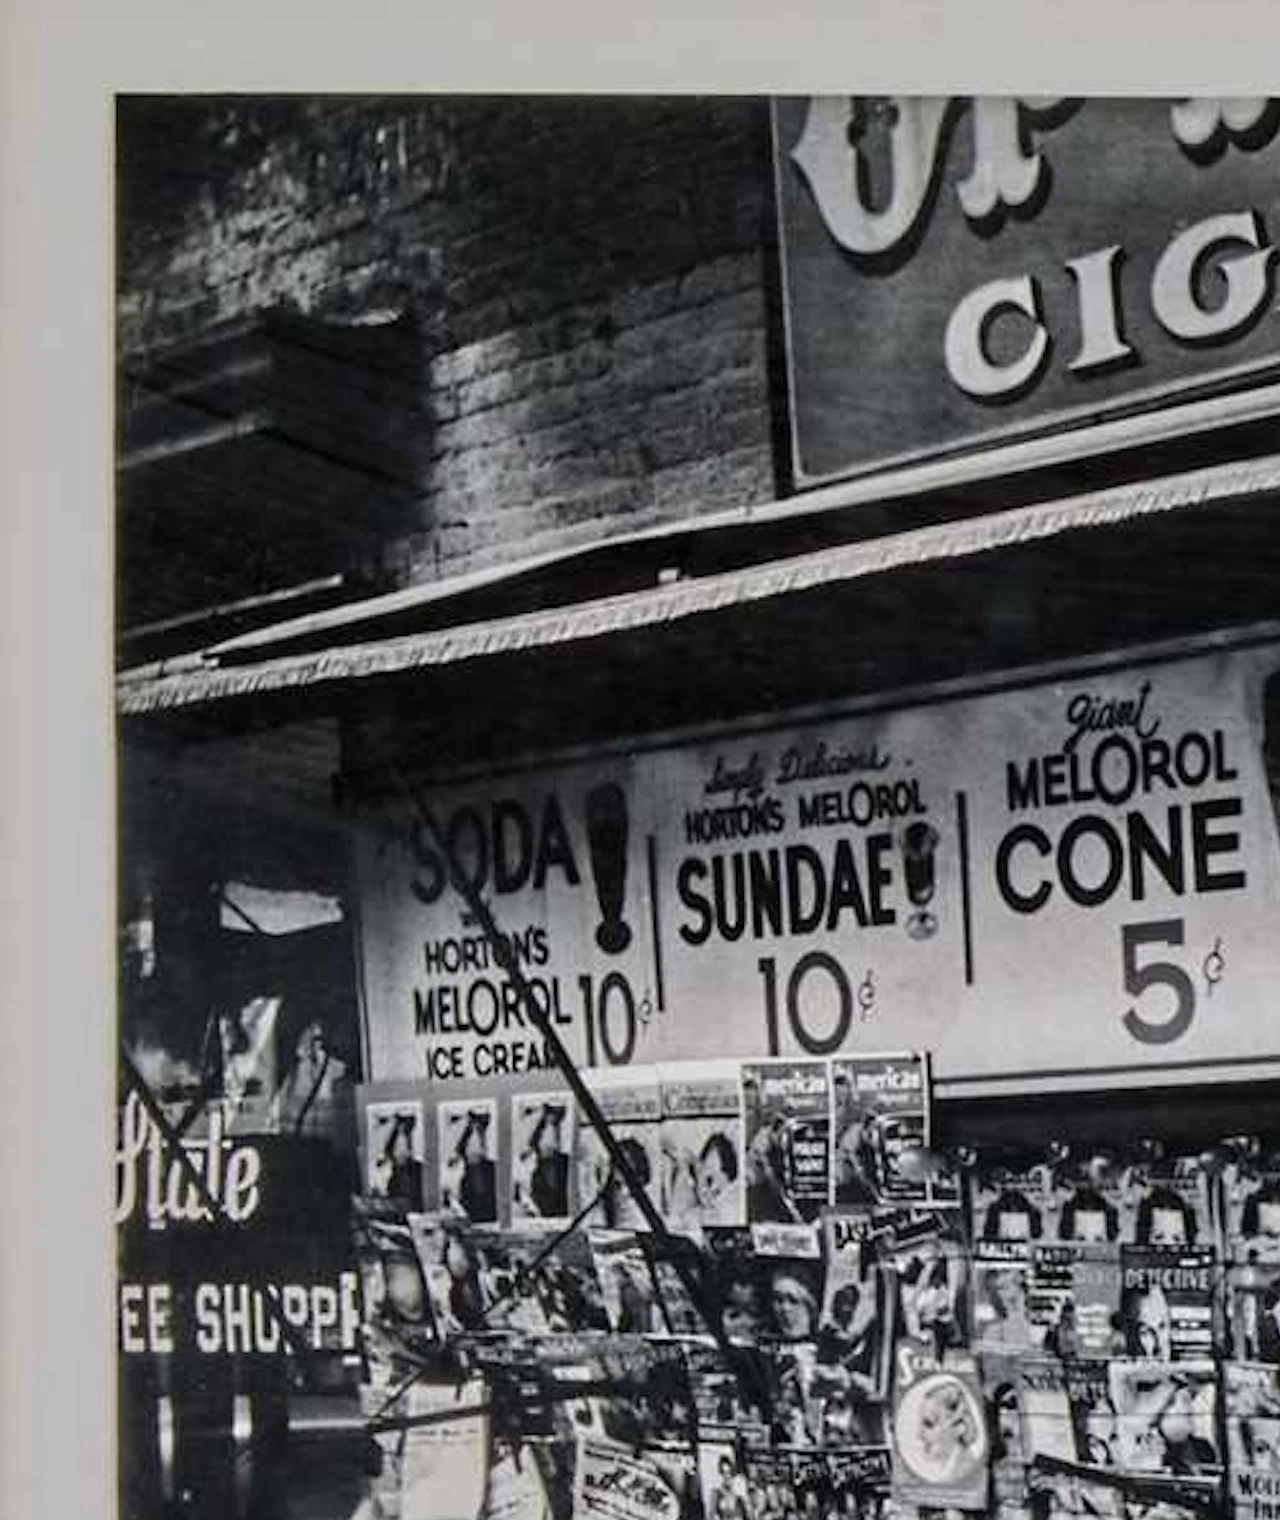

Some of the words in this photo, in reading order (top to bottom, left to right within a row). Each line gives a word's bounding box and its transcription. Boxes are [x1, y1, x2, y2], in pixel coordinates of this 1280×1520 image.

[1067, 674, 1170, 742] Giant
[1006, 728, 1238, 810] MELOROL
[685, 795, 785, 843] HORTON'S
[799, 777, 927, 826] MELOROL
[411, 801, 581, 905] SODA
[998, 797, 1246, 913] CONE
[677, 829, 896, 946] SUNDAE
[423, 929, 551, 972] HORTON'S
[413, 972, 572, 1037] MELOROL
[427, 1047, 464, 1080] ICE
